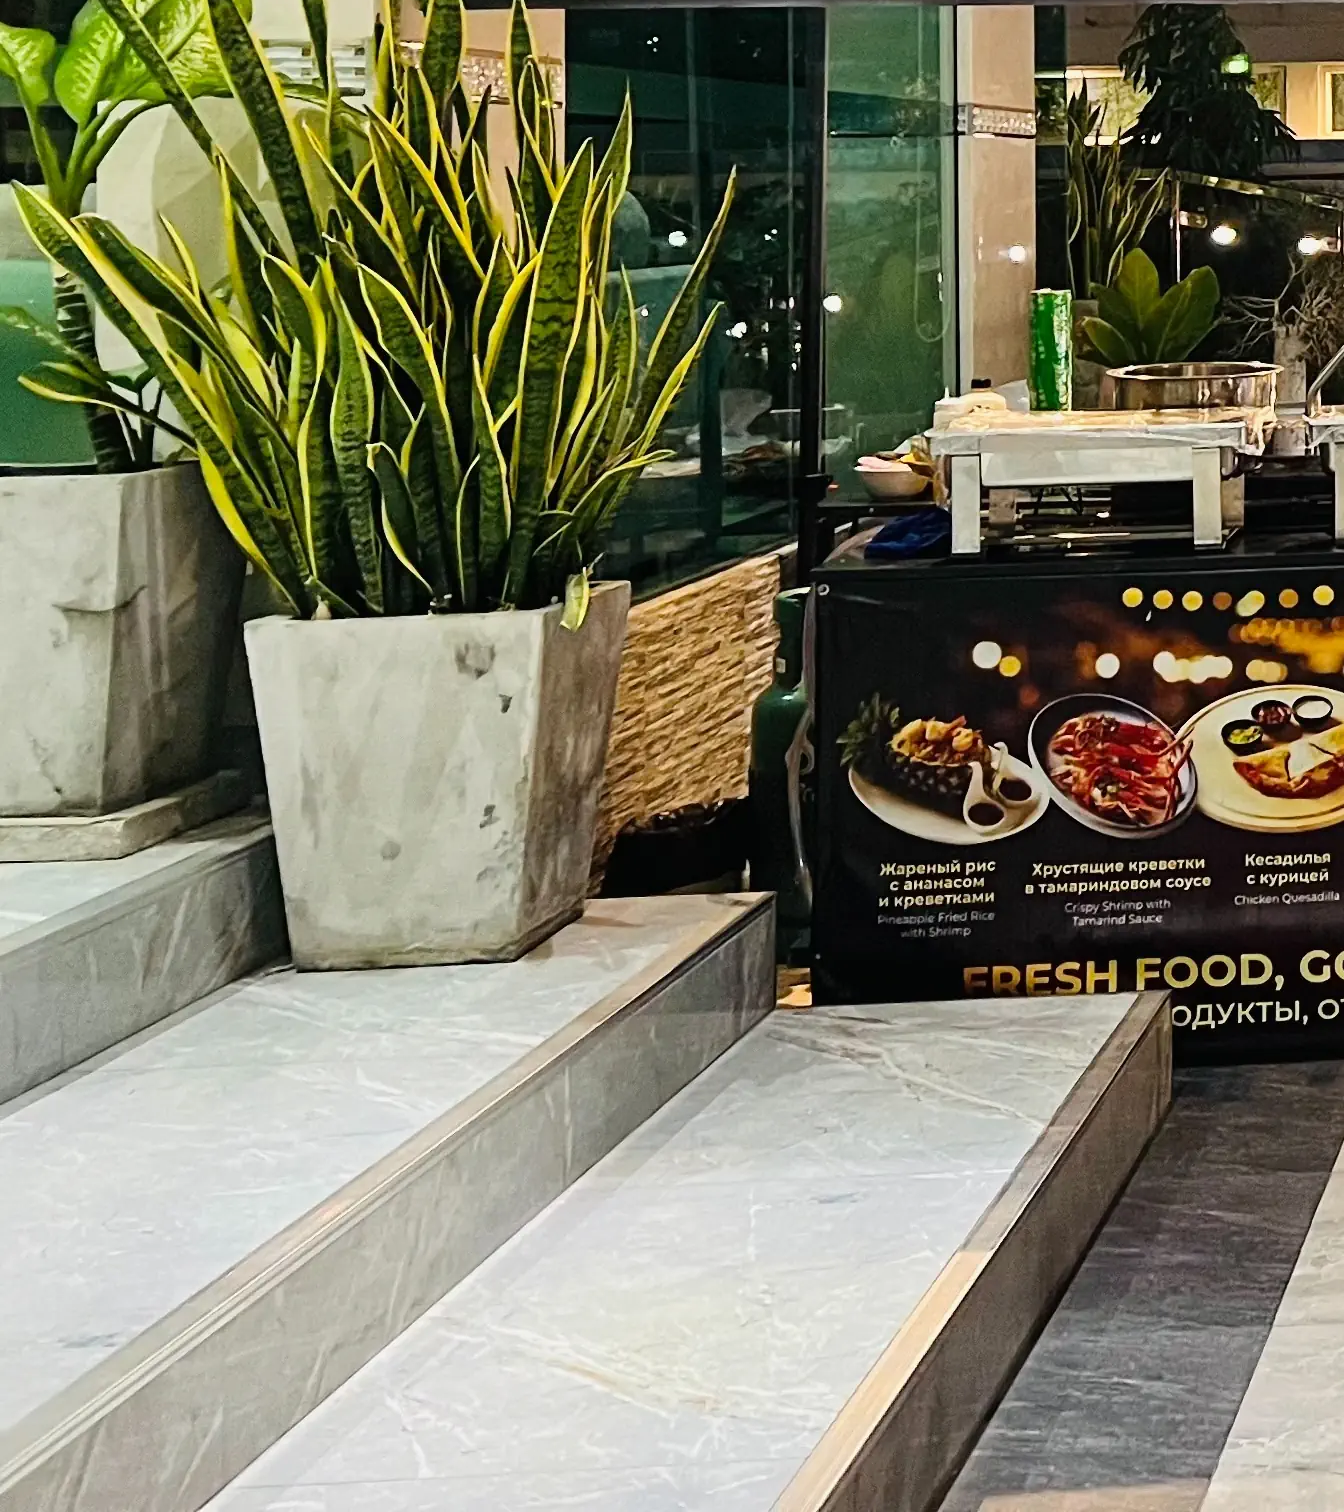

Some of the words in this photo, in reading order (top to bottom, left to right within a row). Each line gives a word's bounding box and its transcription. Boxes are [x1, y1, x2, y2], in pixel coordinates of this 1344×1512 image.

[1032, 862, 1124, 878] Хрустящие
[1128, 858, 1206, 875] креветки
[1245, 852, 1332, 867] Кесадилья
[879, 859, 961, 878] Жареный
[965, 860, 997, 876] рис
[889, 880, 900, 891] с
[903, 877, 985, 891] ананасом
[1025, 884, 1034, 894] в
[1038, 878, 1162, 895] тамариндовом
[1165, 875, 1212, 891] соусе
[1246, 874, 1256, 885] с
[1260, 868, 1329, 887] курицей
[878, 896, 889, 907] и
[894, 891, 995, 909] креветками
[1064, 902, 1100, 915] Crispy
[1102, 899, 1144, 912] Shrimp
[1146, 899, 1171, 909] with
[1234, 894, 1280, 906] Chicken
[1281, 891, 1340, 905] Quesadilla
[877, 912, 935, 926] Pineapple
[938, 910, 968, 923] Fried
[970, 910, 995, 922] Rice
[1072, 915, 1126, 927] Tamarind
[1128, 913, 1163, 925] Sauce
[929, 926, 972, 938] Shrimp
[963, 960, 1119, 997] FRESH
[1136, 953, 1285, 991] FOOD,
[1172, 1000, 1309, 1030] ОДУКТЫ,
